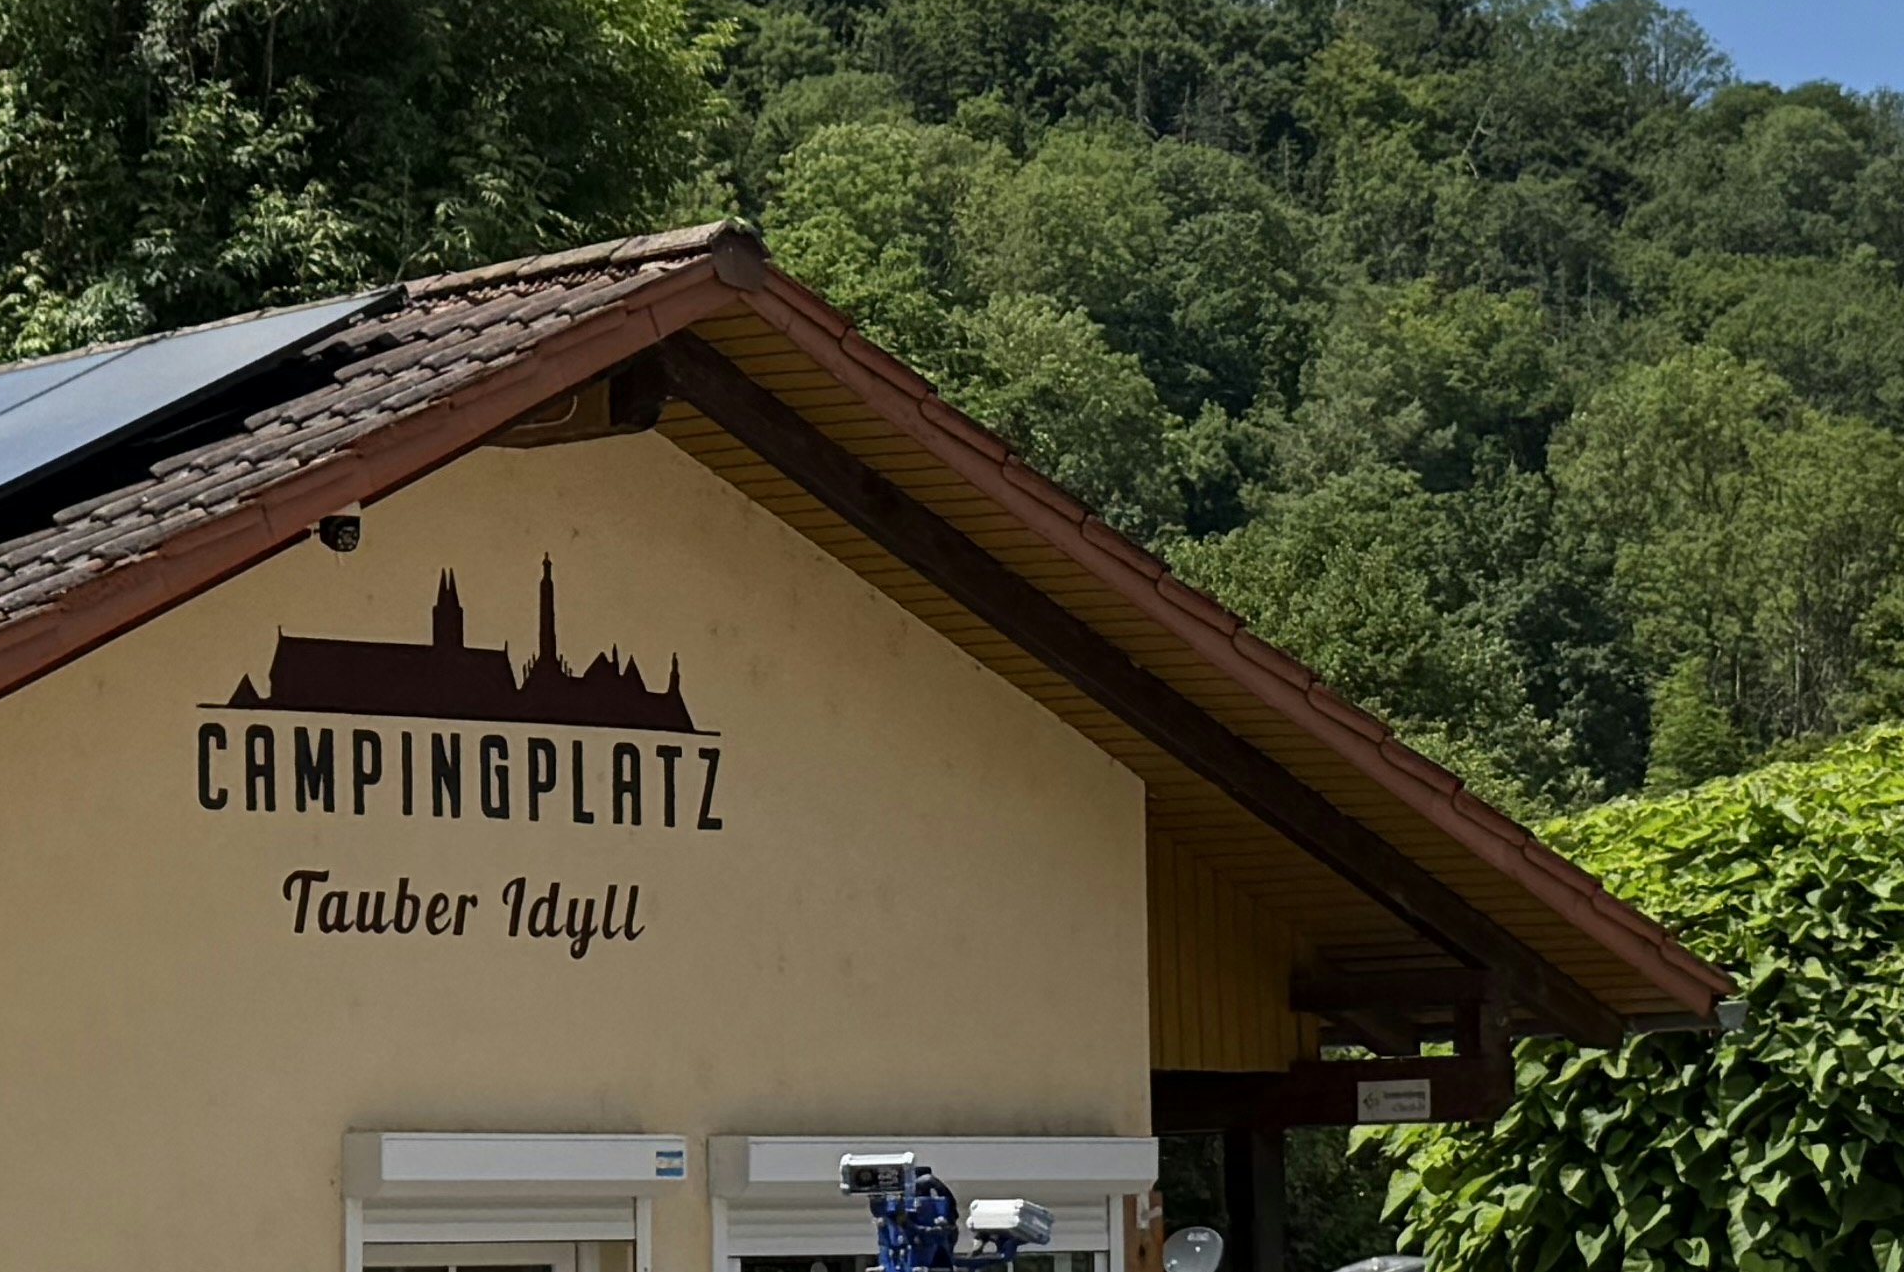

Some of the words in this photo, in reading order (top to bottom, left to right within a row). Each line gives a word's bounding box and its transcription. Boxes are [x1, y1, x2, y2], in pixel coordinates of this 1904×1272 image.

[197, 722, 723, 830] CAMPINGPLATZ
[282, 869, 478, 936] Tauber
[502, 877, 645, 959] Idyll
